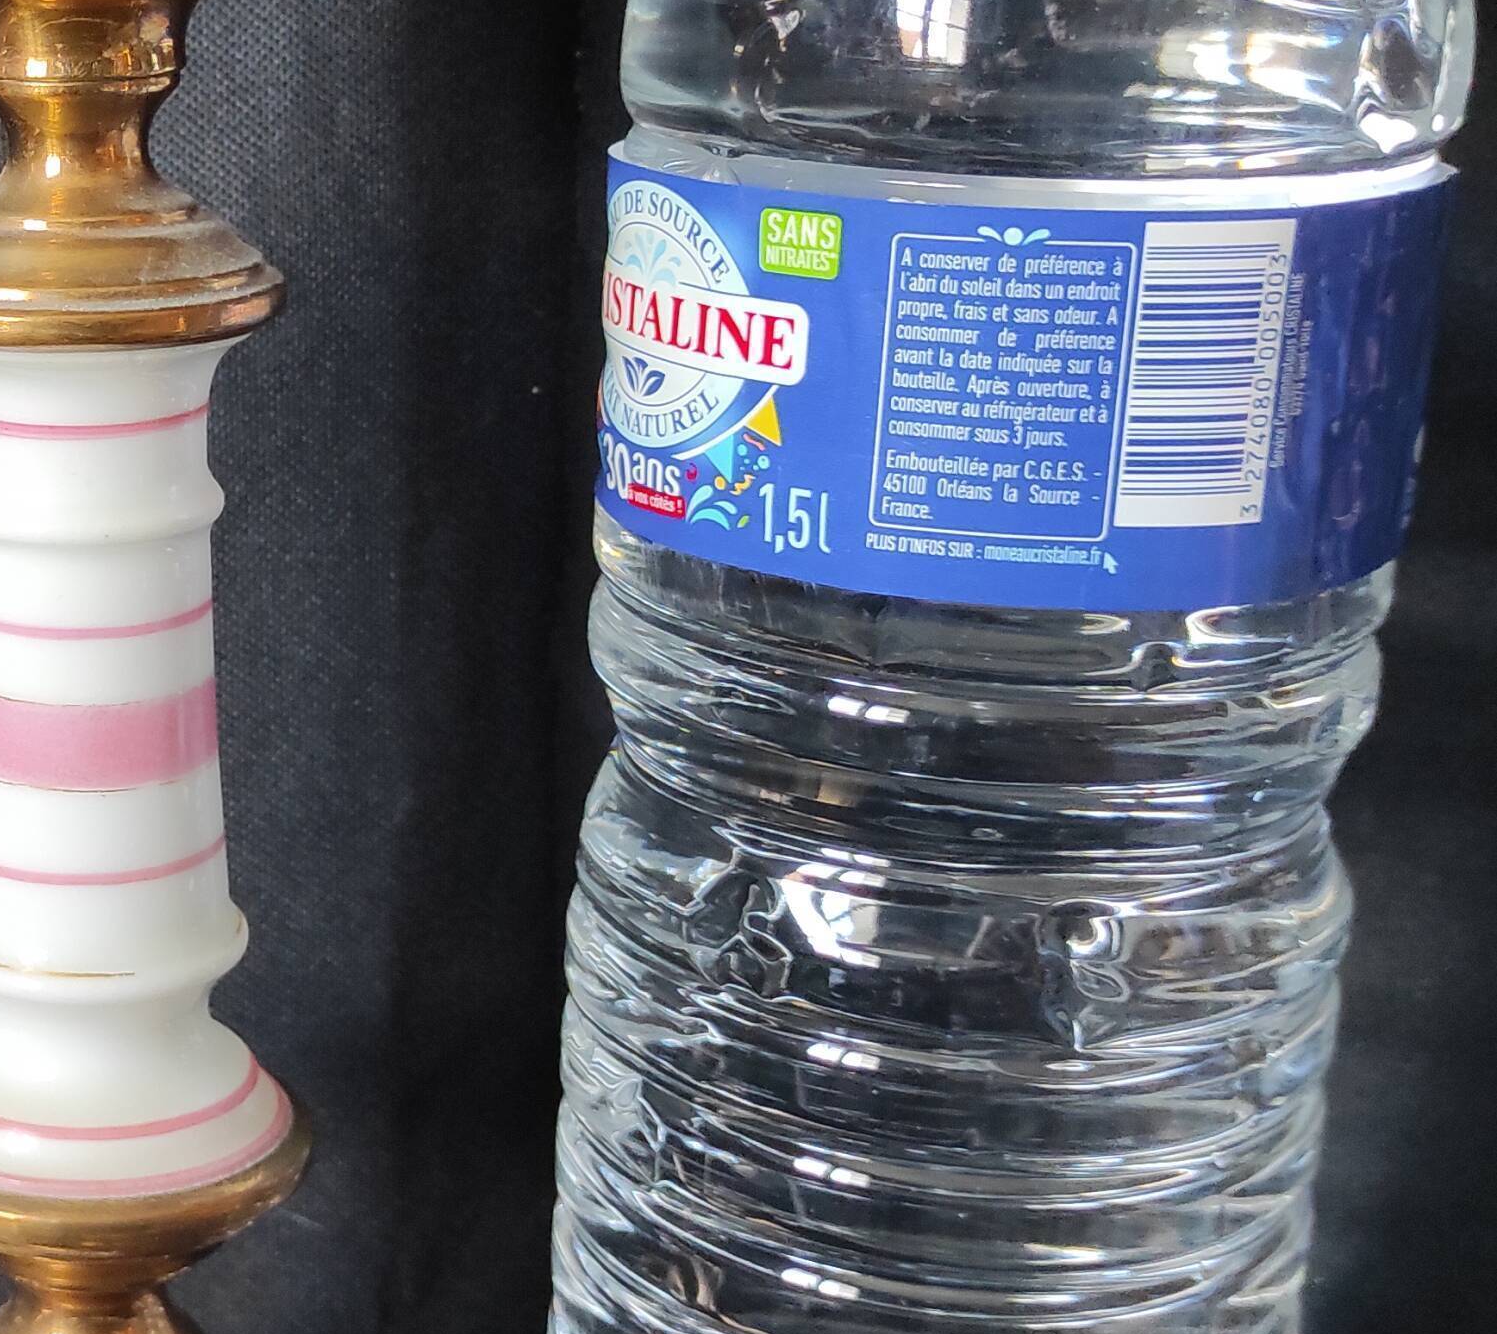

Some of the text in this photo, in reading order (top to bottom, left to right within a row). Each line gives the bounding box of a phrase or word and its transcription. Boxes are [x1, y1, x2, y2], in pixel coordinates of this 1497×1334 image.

[624, 189, 644, 215] DE
[648, 191, 730, 284] SOURCE
[767, 212, 837, 249] SANS
[901, 247, 1123, 278] A conserver de préférence à
[900, 272, 1120, 301] l'abri du soleil dans un endroit
[603, 271, 795, 369] ISTALINE
[954, 300, 986, 321] frais
[992, 304, 1008, 322] et
[1013, 307, 1049, 324] sans
[1054, 305, 1101, 325] odeur.
[1106, 305, 1118, 325] A
[896, 324, 1116, 352] consommer de préférence
[894, 348, 1113, 377] avant la date indiquée sur la
[892, 368, 960, 393] bouteille.
[967, 374, 1010, 398] Après
[1100, 380, 1111, 399] à
[1240, 253, 1288, 519] 3 274080 005003
[621, 389, 720, 437] NATUREL
[890, 395, 1109, 425] conserver au réfrigérateur et à
[889, 419, 1067, 449] consommer sous 3 jours.
[886, 449, 989, 477] Embouteillée
[993, 463, 1021, 482] par
[1024, 460, 1088, 482] C.G.E.S.
[883, 472, 927, 495] 45100
[937, 477, 992, 501] Orléans
[1003, 482, 1018, 502] la
[1029, 484, 1080, 506] Source
[882, 495, 933, 519] France.
[866, 533, 895, 552] PLUS
[899, 537, 945, 556] D'INFOS
[947, 541, 974, 559] SUR
